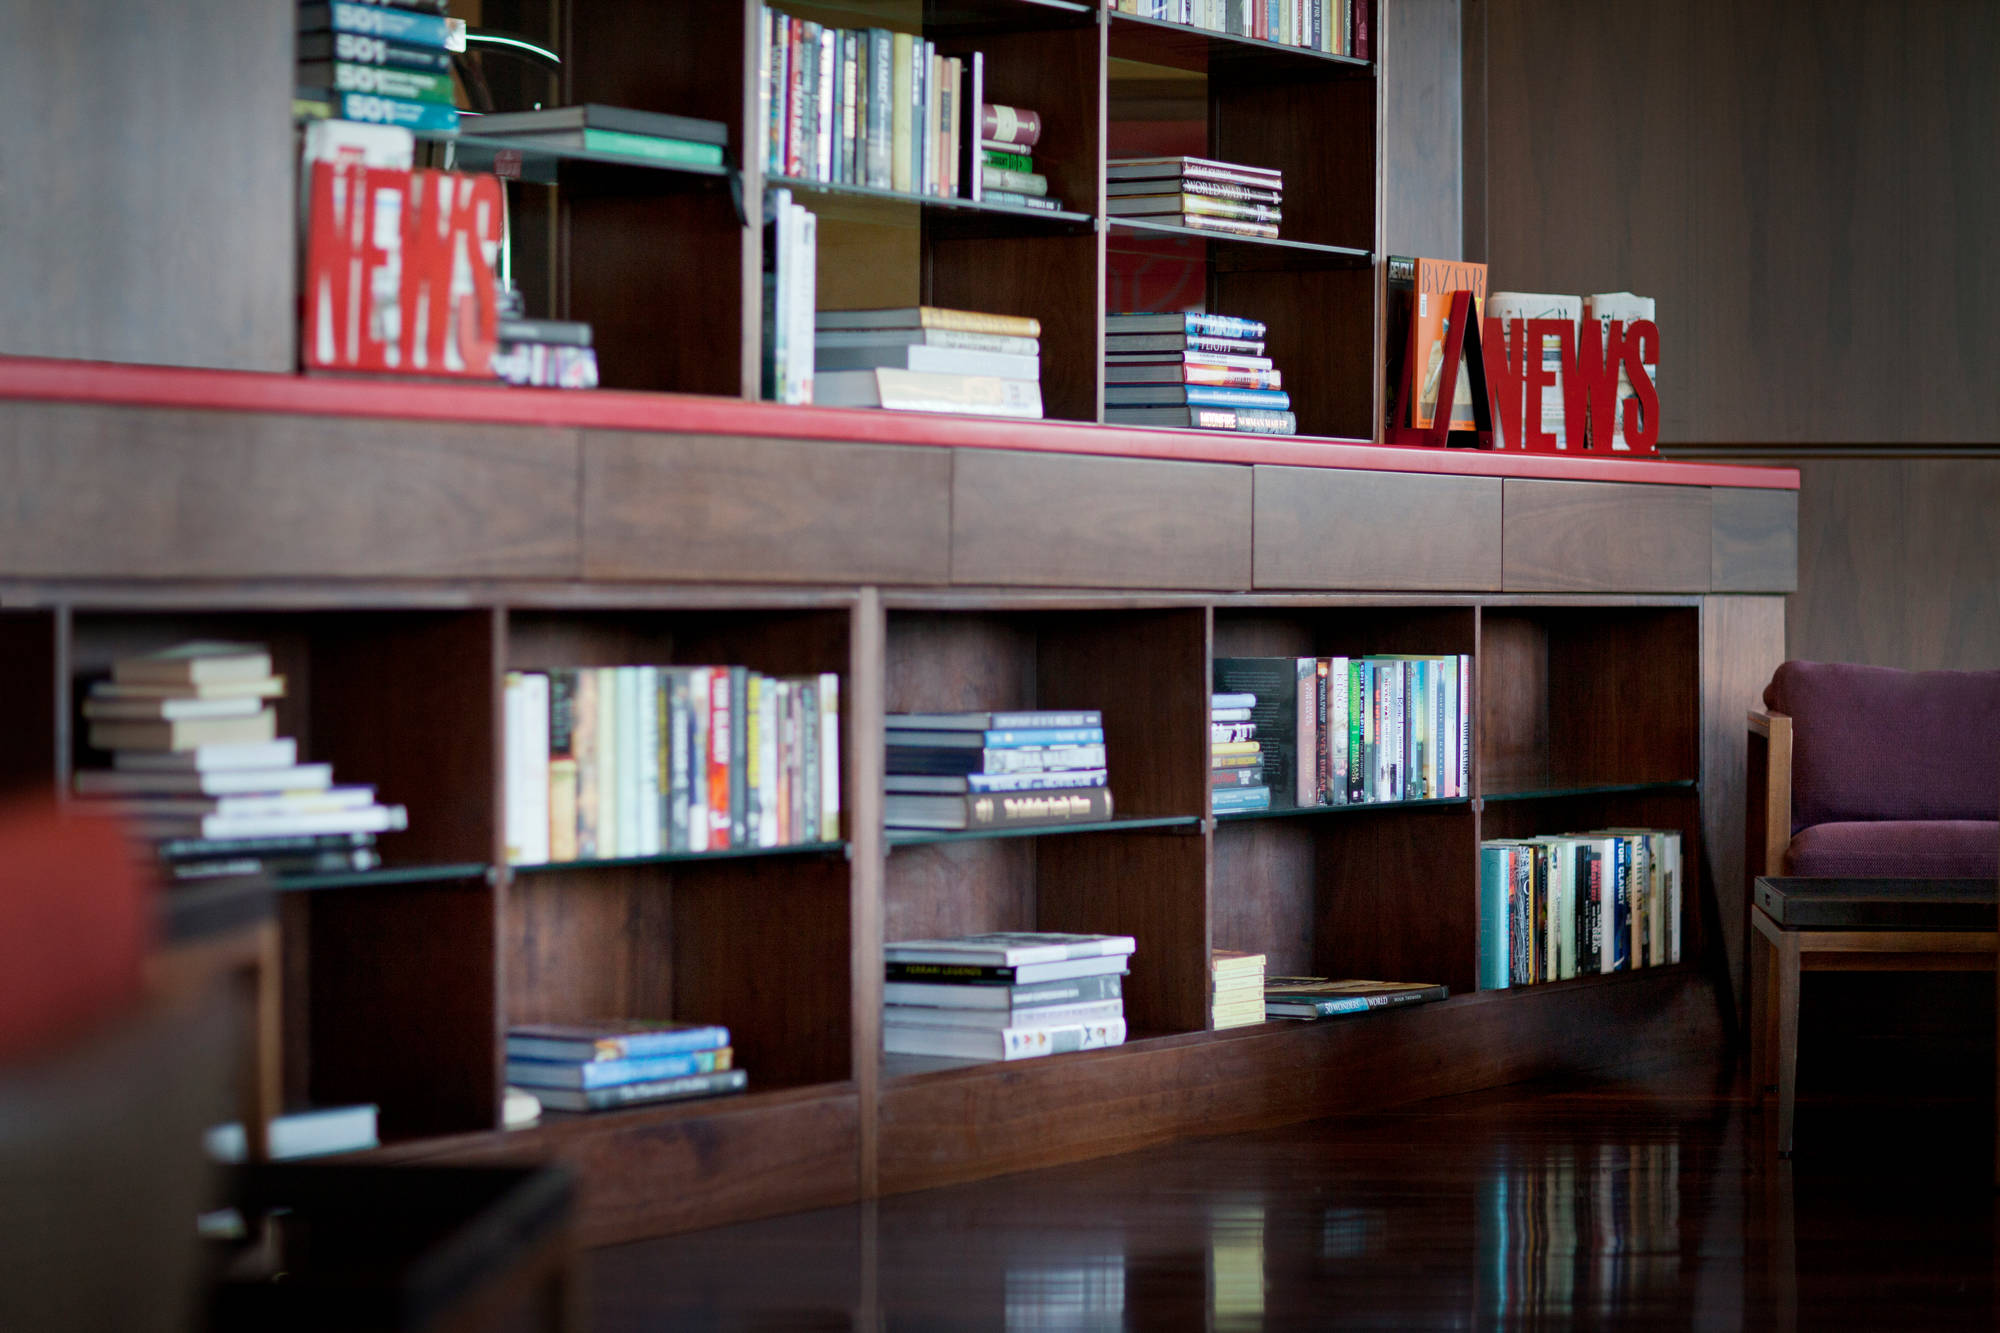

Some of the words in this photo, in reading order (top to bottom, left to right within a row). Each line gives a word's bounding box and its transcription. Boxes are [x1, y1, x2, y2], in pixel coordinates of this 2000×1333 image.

[336, 34, 386, 64] 501
[336, 63, 382, 93] 501
[346, 94, 394, 124] 501
[1186, 180, 1221, 196] WORLD
[1422, 263, 1483, 298] BAZAAR
[1484, 318, 1660, 452] NEWS
[1617, 842, 1625, 864] TOM
[1617, 866, 1625, 905] CLANCY
[1367, 996, 1388, 1006] WORLD
